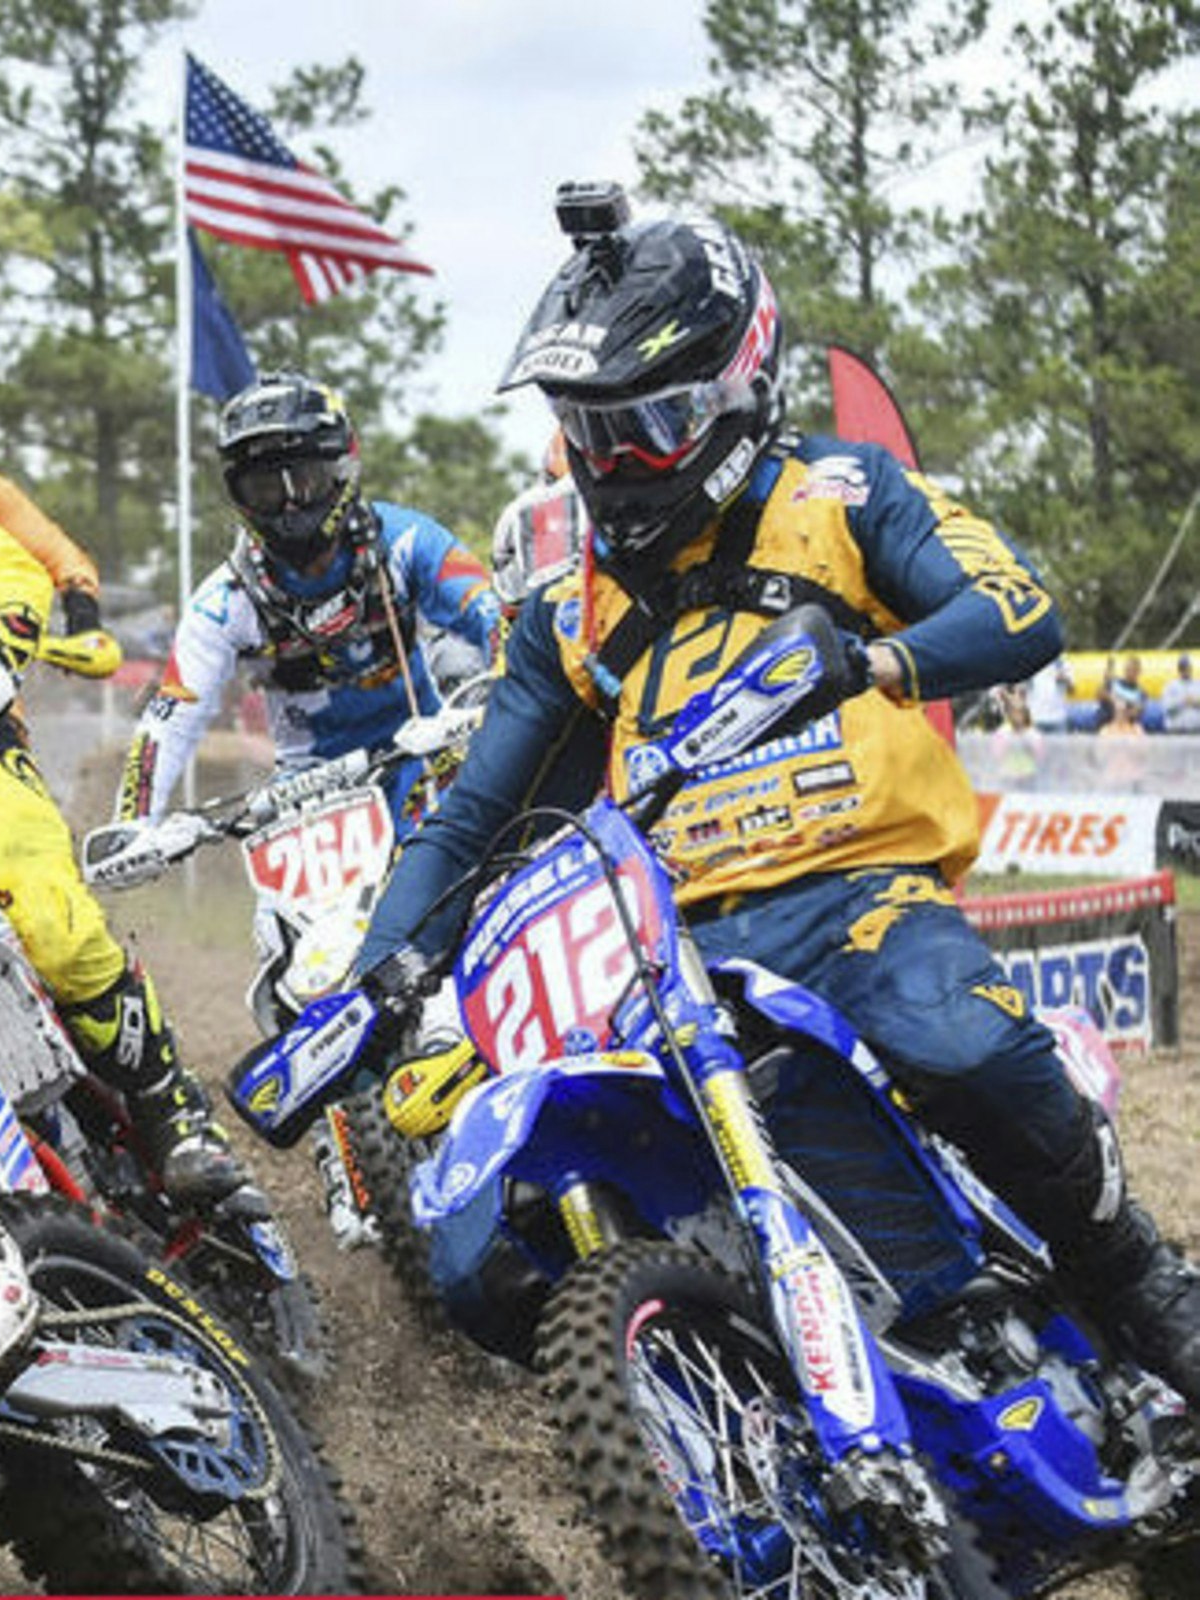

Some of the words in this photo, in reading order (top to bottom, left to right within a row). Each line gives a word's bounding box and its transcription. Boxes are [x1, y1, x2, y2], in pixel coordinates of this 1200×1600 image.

[266, 803, 378, 898] 264
[996, 810, 1127, 858] TIRES
[485, 875, 642, 1072] 212
[145, 1269, 249, 1367] DUNLOP
